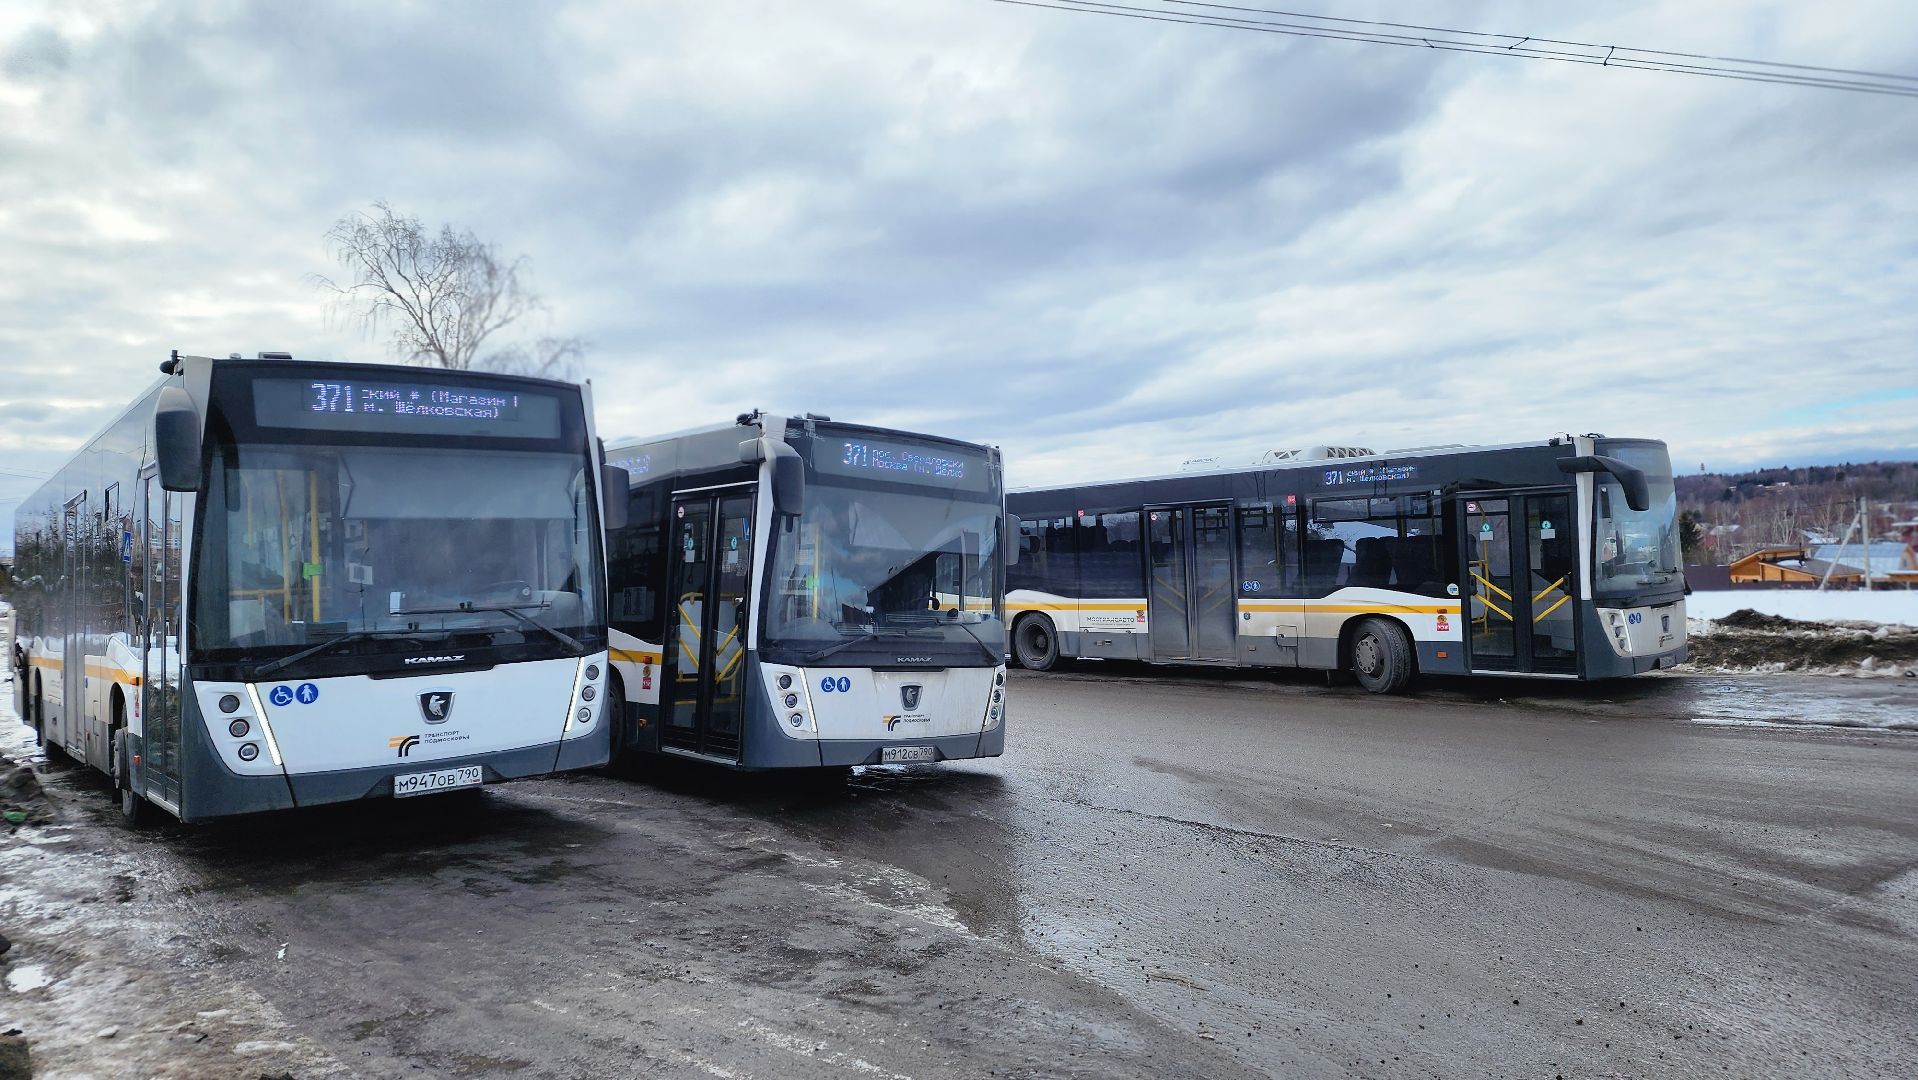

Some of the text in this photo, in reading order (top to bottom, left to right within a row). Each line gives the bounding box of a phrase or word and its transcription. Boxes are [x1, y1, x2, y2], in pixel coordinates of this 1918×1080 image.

[312, 383, 353, 412] 371
[843, 443, 867, 467] 371
[1325, 470, 1343, 485] 371
[404, 654, 465, 665] KAMAZ
[424, 730, 460, 738] ТРАНСПОРТ
[457, 767, 479, 780] 790
